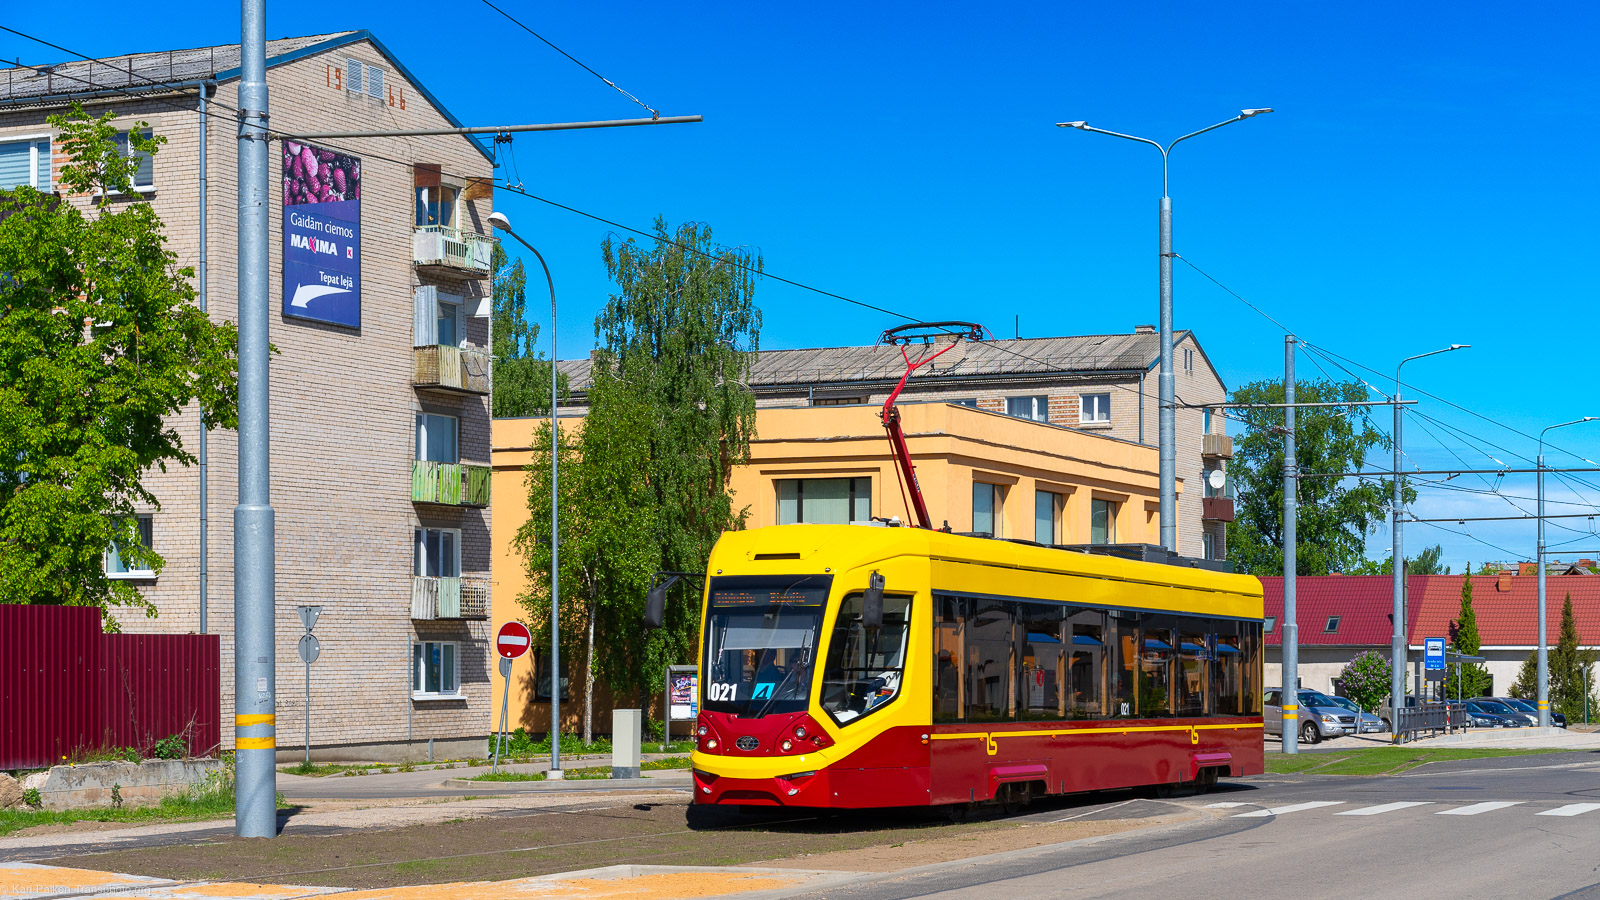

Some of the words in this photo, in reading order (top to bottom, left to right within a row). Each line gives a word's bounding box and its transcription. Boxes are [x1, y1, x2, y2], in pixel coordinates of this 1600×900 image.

[327, 64, 341, 90] 19
[389, 84, 405, 110] 66
[291, 212, 323, 231] Gaidām
[325, 221, 353, 238] ciemos
[291, 233, 338, 256] MAXIMA
[319, 271, 339, 286] Tepat
[340, 275, 353, 289] lejā
[710, 682, 737, 701] 021
